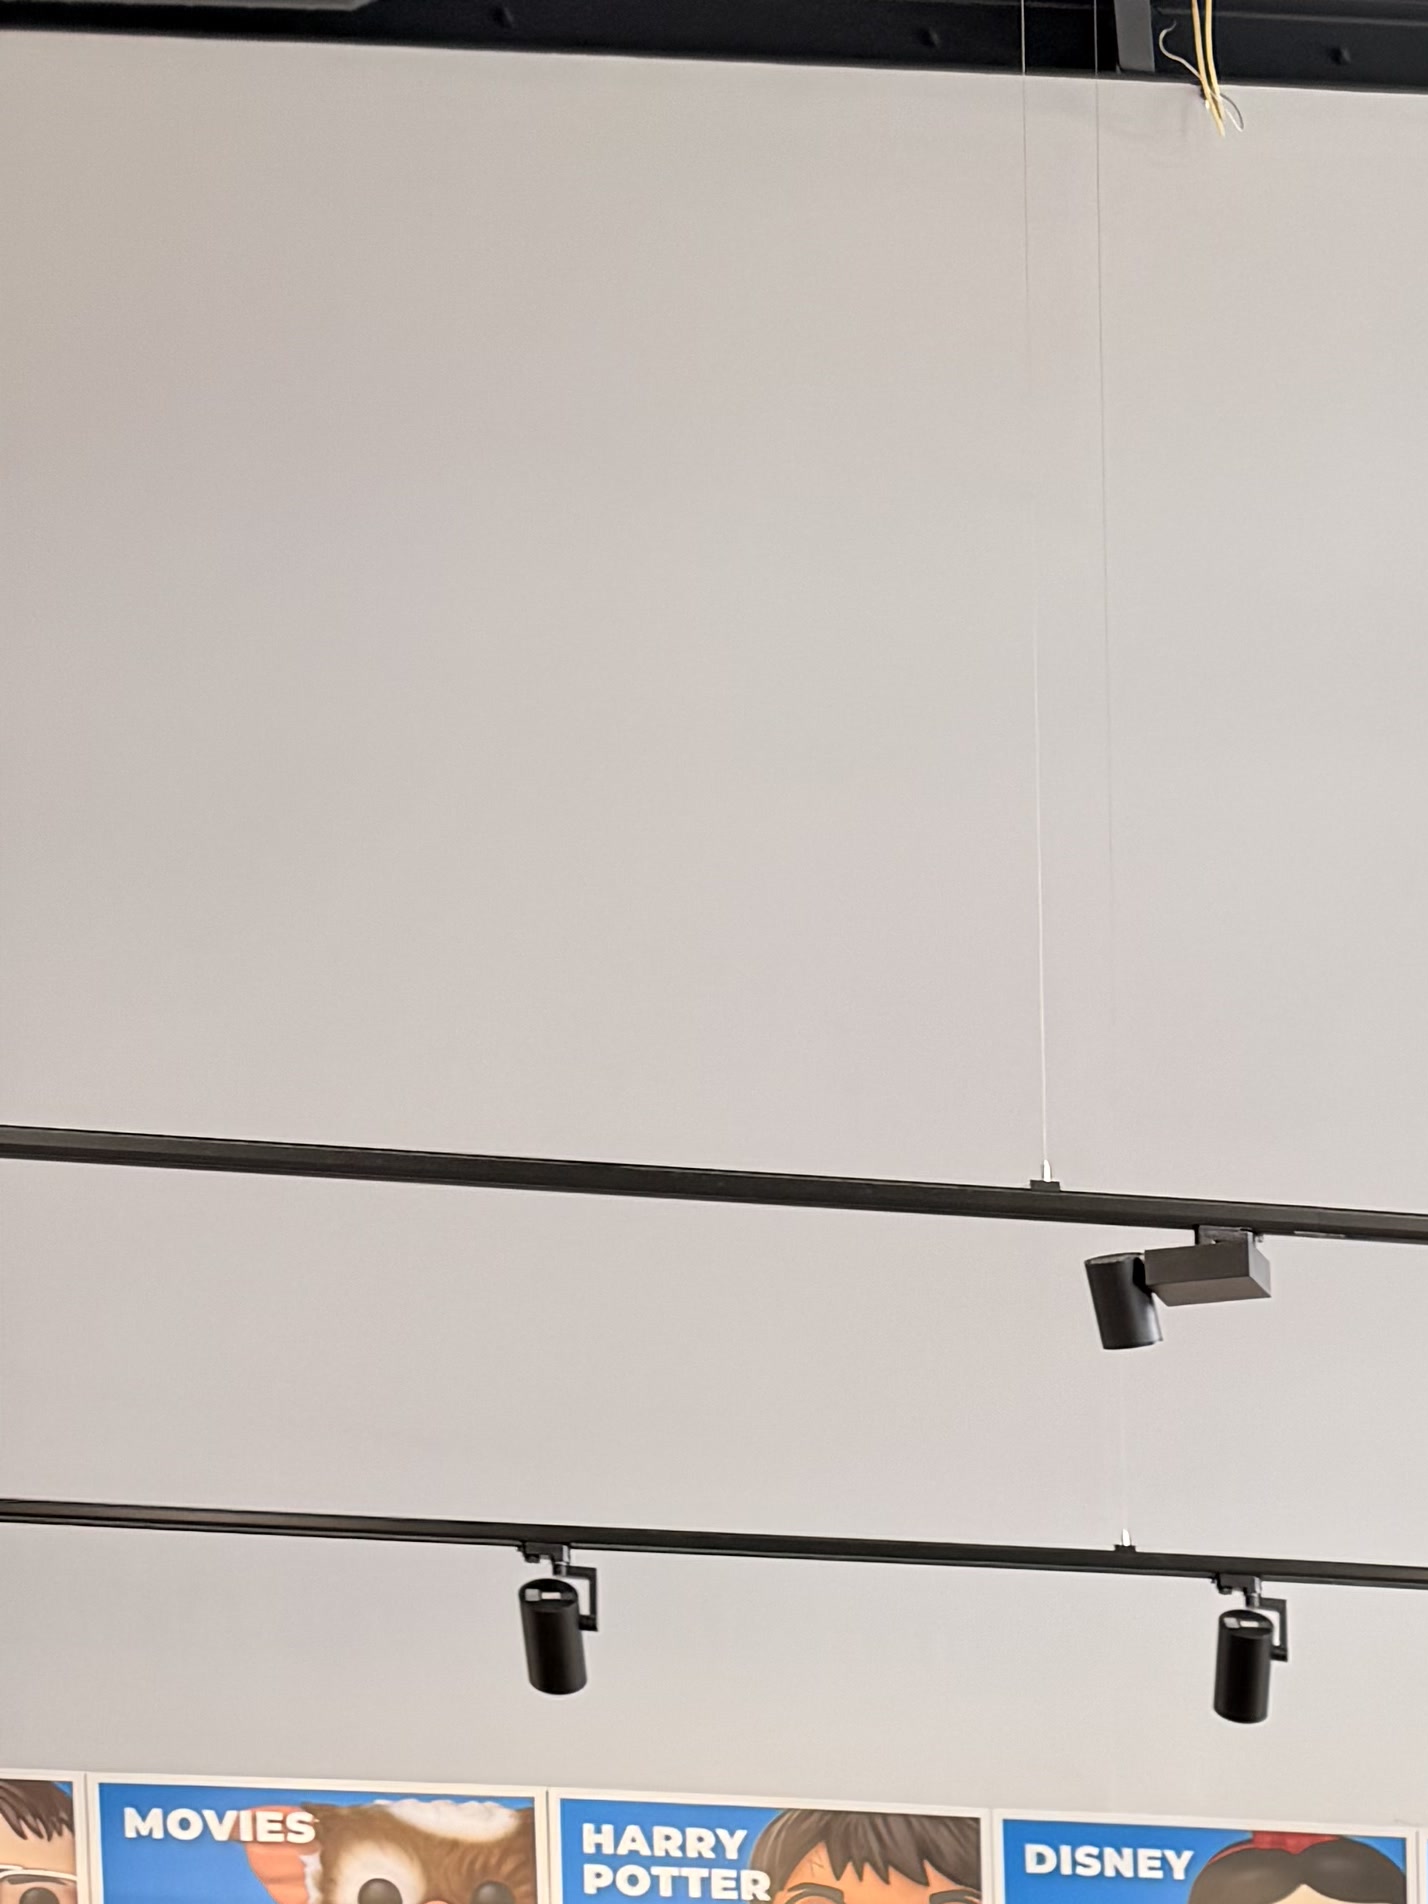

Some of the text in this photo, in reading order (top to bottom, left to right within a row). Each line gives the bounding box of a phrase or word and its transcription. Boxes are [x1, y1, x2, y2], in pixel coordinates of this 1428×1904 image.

[124, 1808, 317, 1844] MOVIES
[582, 1823, 747, 1860] HARRY
[1023, 1843, 1194, 1881] DISNEY
[582, 1864, 772, 1903] POTTER
